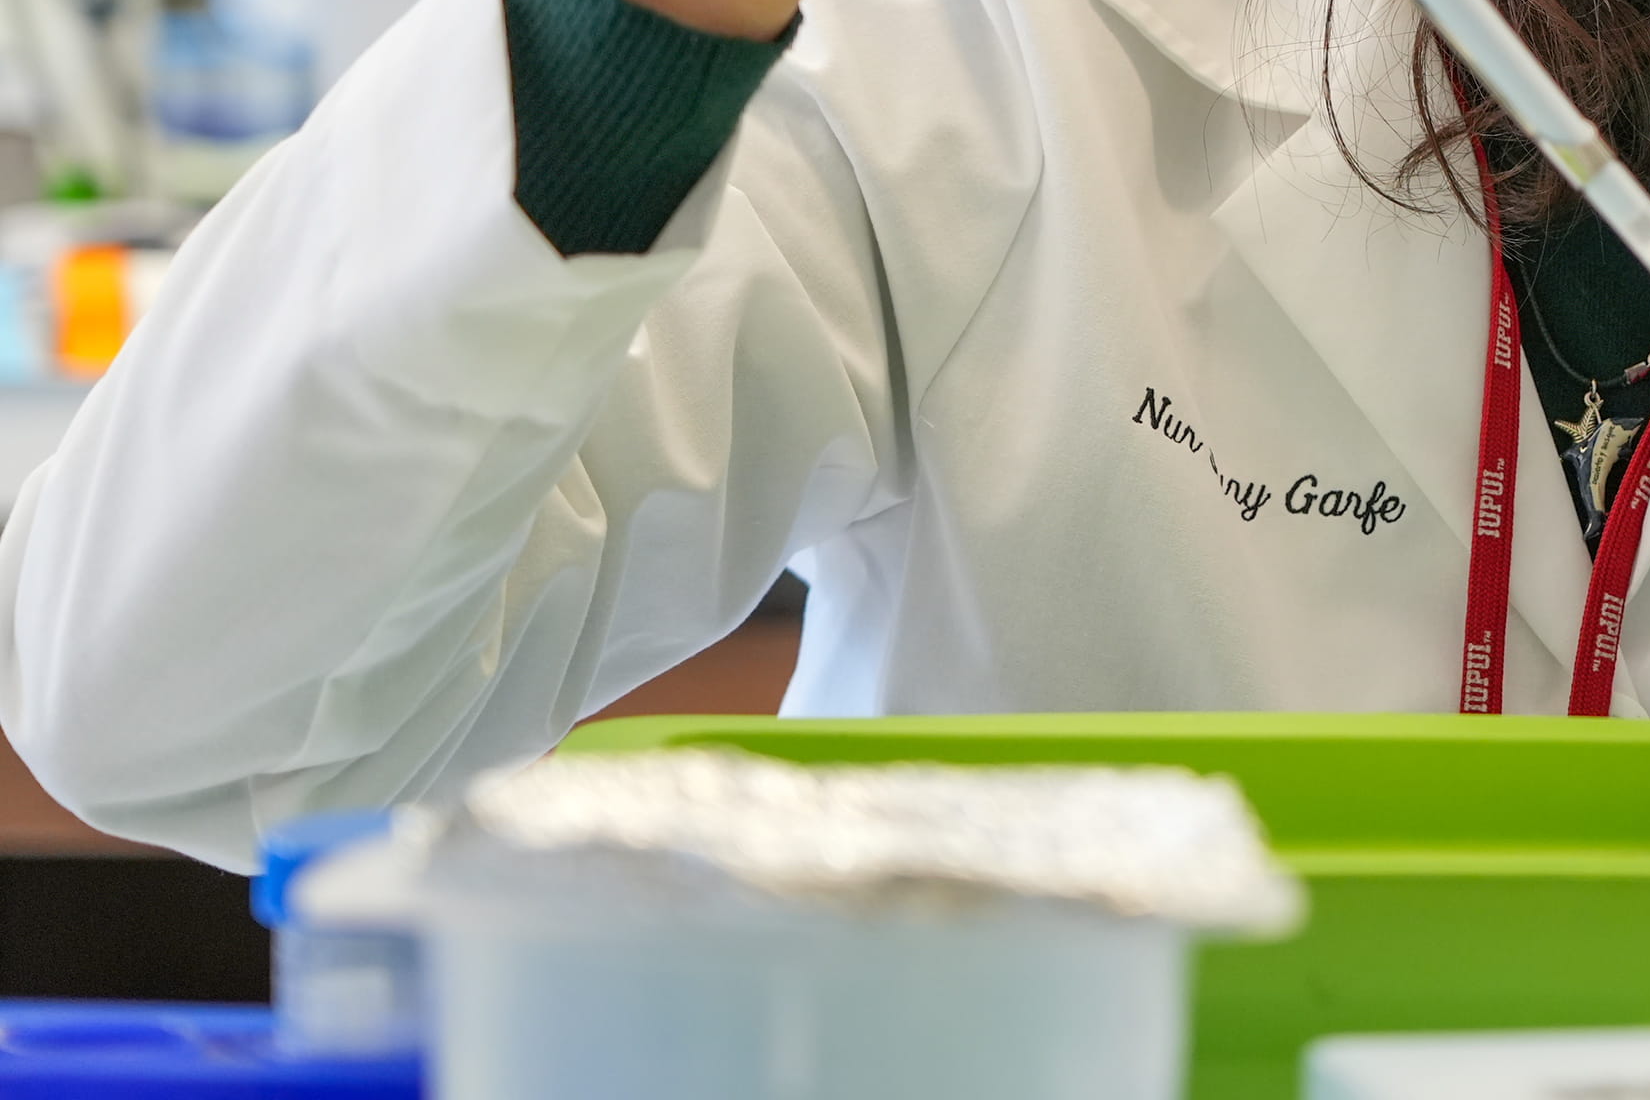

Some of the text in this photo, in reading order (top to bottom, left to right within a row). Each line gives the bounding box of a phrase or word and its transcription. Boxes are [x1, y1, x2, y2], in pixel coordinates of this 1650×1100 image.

[1494, 300, 1512, 370] IUPUI
[1285, 474, 1407, 536] Garfe
[1477, 468, 1505, 539] IUPUI
[1594, 592, 1624, 662] IUPUI
[1463, 642, 1492, 713] IUPUI
